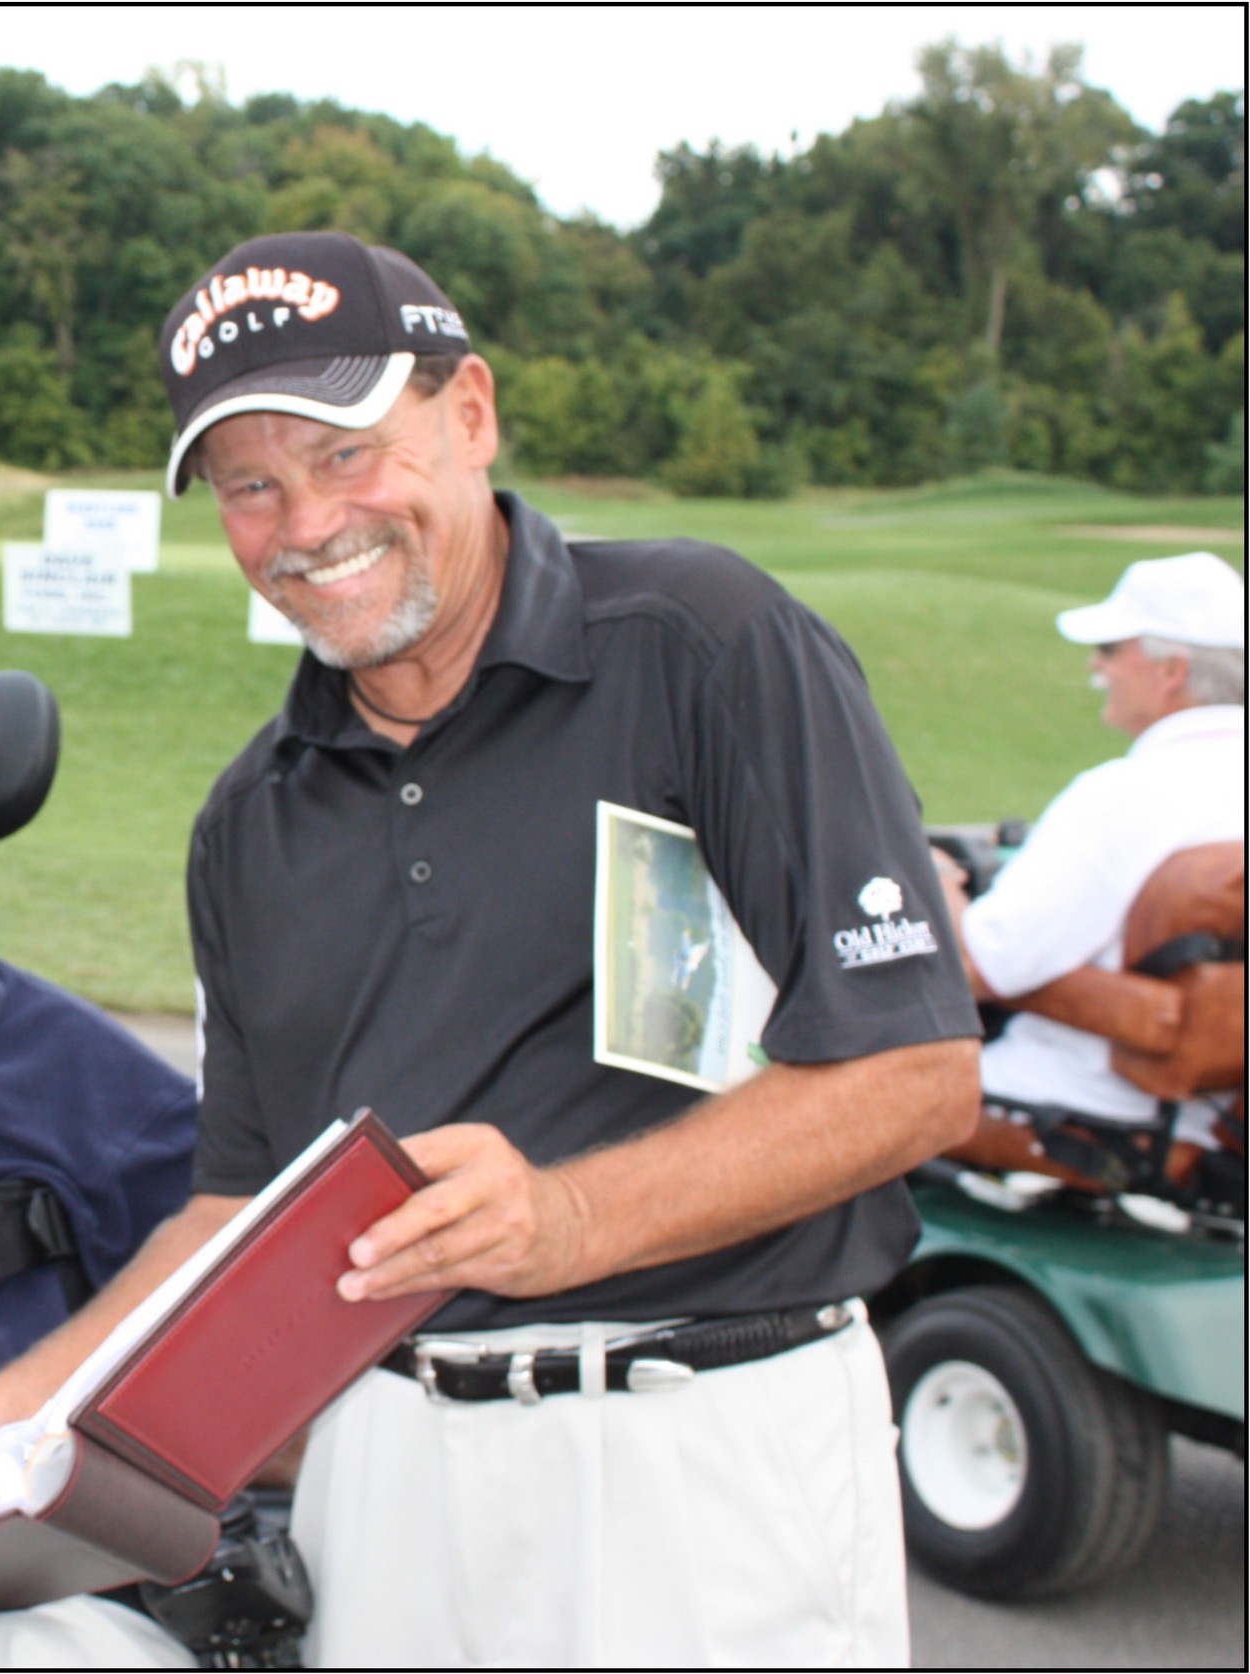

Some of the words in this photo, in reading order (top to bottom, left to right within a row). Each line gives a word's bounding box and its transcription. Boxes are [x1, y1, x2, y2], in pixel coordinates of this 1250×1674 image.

[171, 266, 340, 376] Callaway
[198, 306, 291, 360] GOLF
[399, 304, 438, 335] FT
[833, 925, 873, 951] Old
[872, 917, 930, 945] Hick
